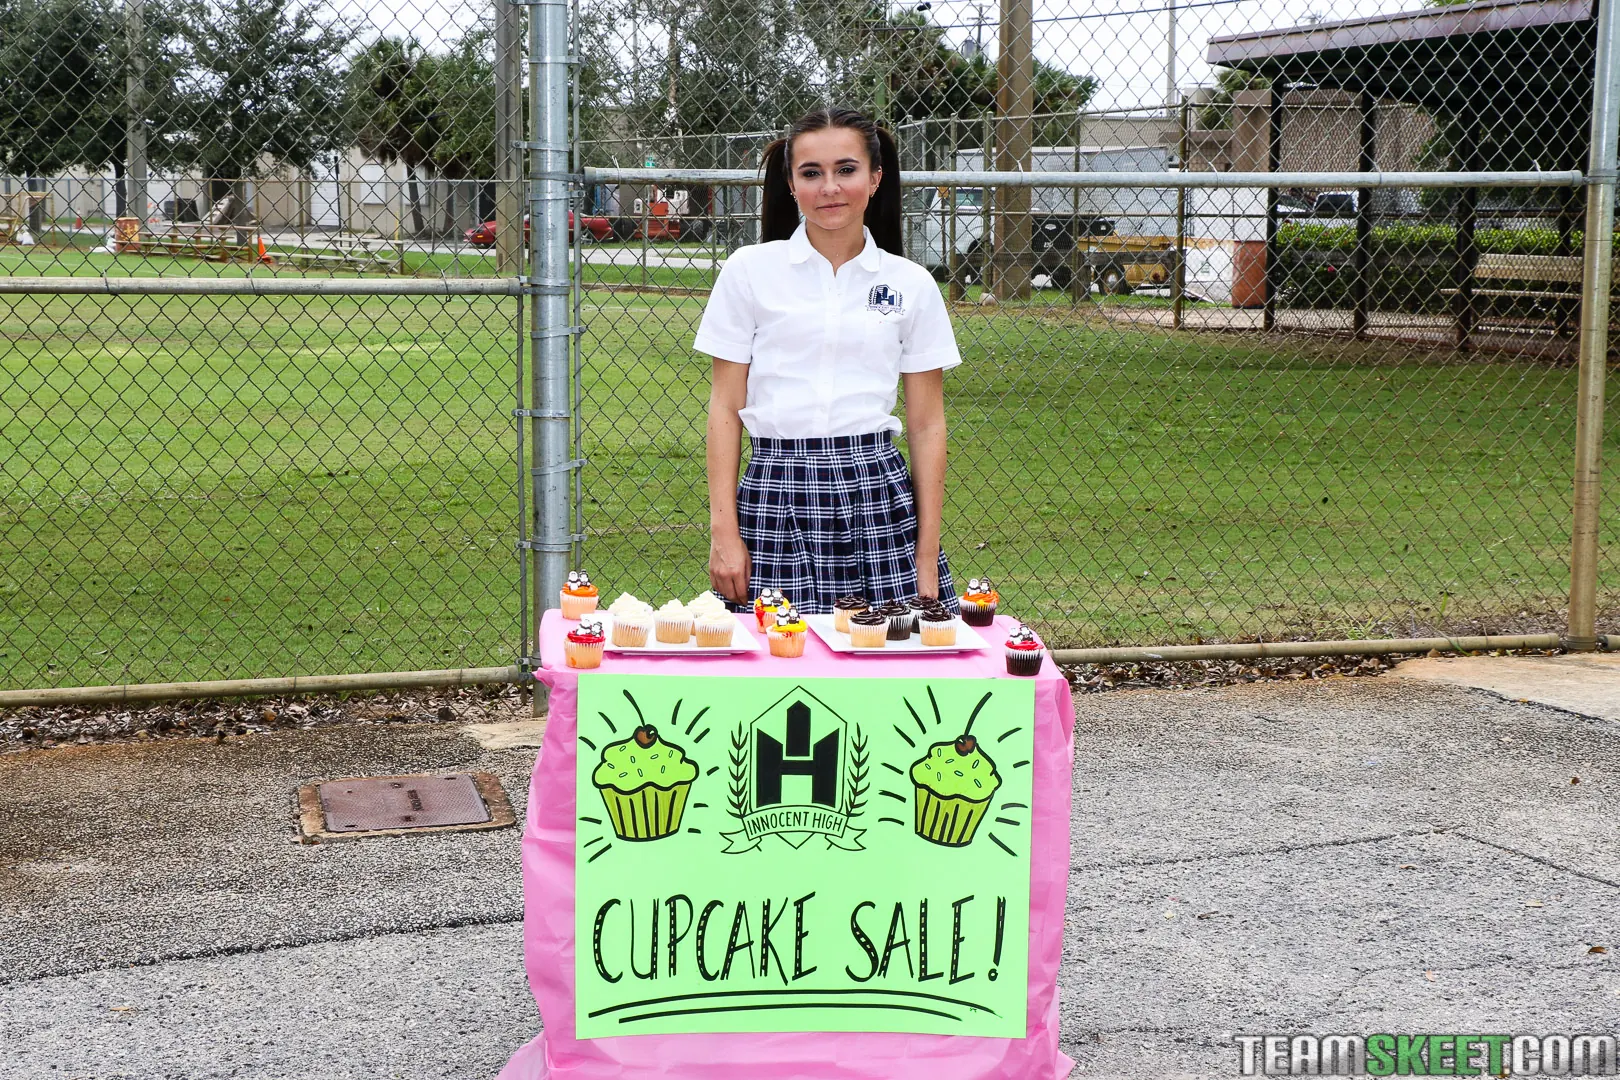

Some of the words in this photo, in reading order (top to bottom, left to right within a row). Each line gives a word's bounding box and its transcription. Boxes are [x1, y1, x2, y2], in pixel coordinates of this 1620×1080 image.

[747, 811, 809, 835] INNOCENT
[812, 812, 844, 832] HIGH
[592, 891, 818, 986] CUPCAKE
[845, 895, 1006, 985] SALE!
